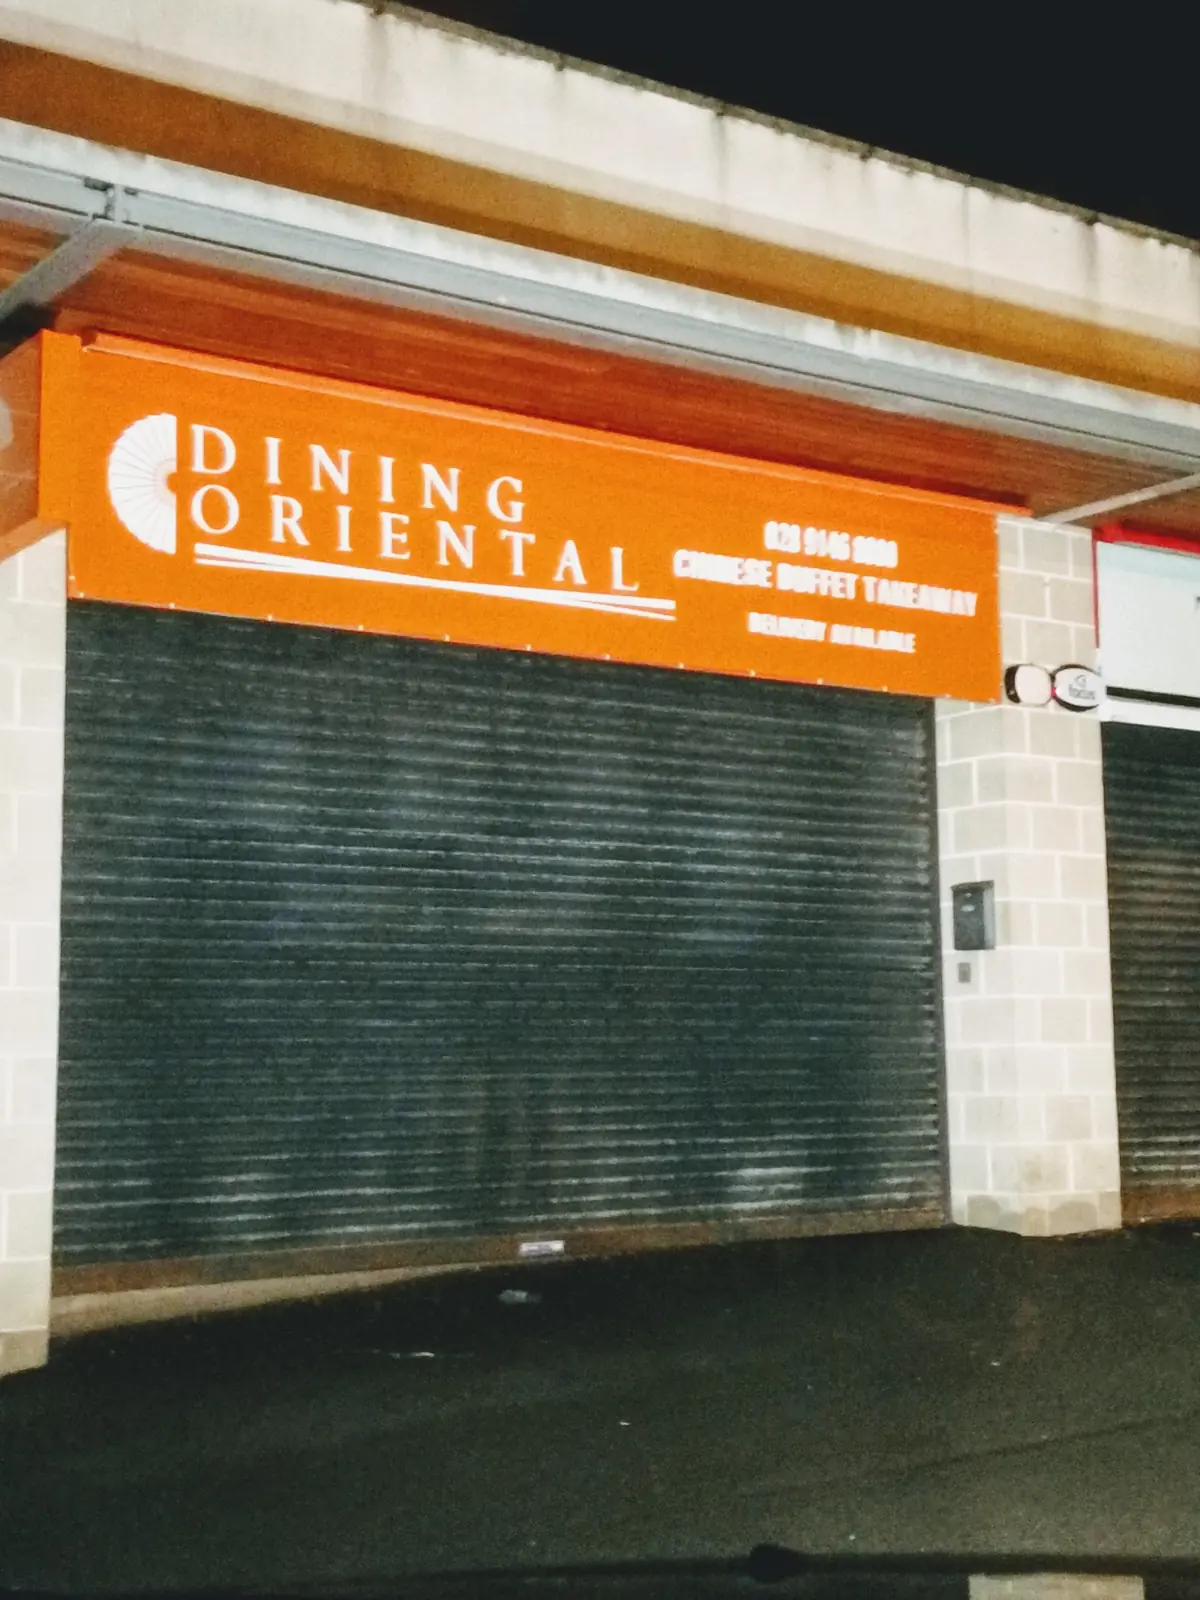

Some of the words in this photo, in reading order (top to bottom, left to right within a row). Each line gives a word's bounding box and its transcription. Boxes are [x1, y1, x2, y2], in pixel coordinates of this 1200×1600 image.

[191, 423, 525, 523] DINING
[190, 485, 638, 592] ORIENTAL
[776, 563, 859, 600] BUFFET
[862, 575, 978, 617] TAKEAWAY
